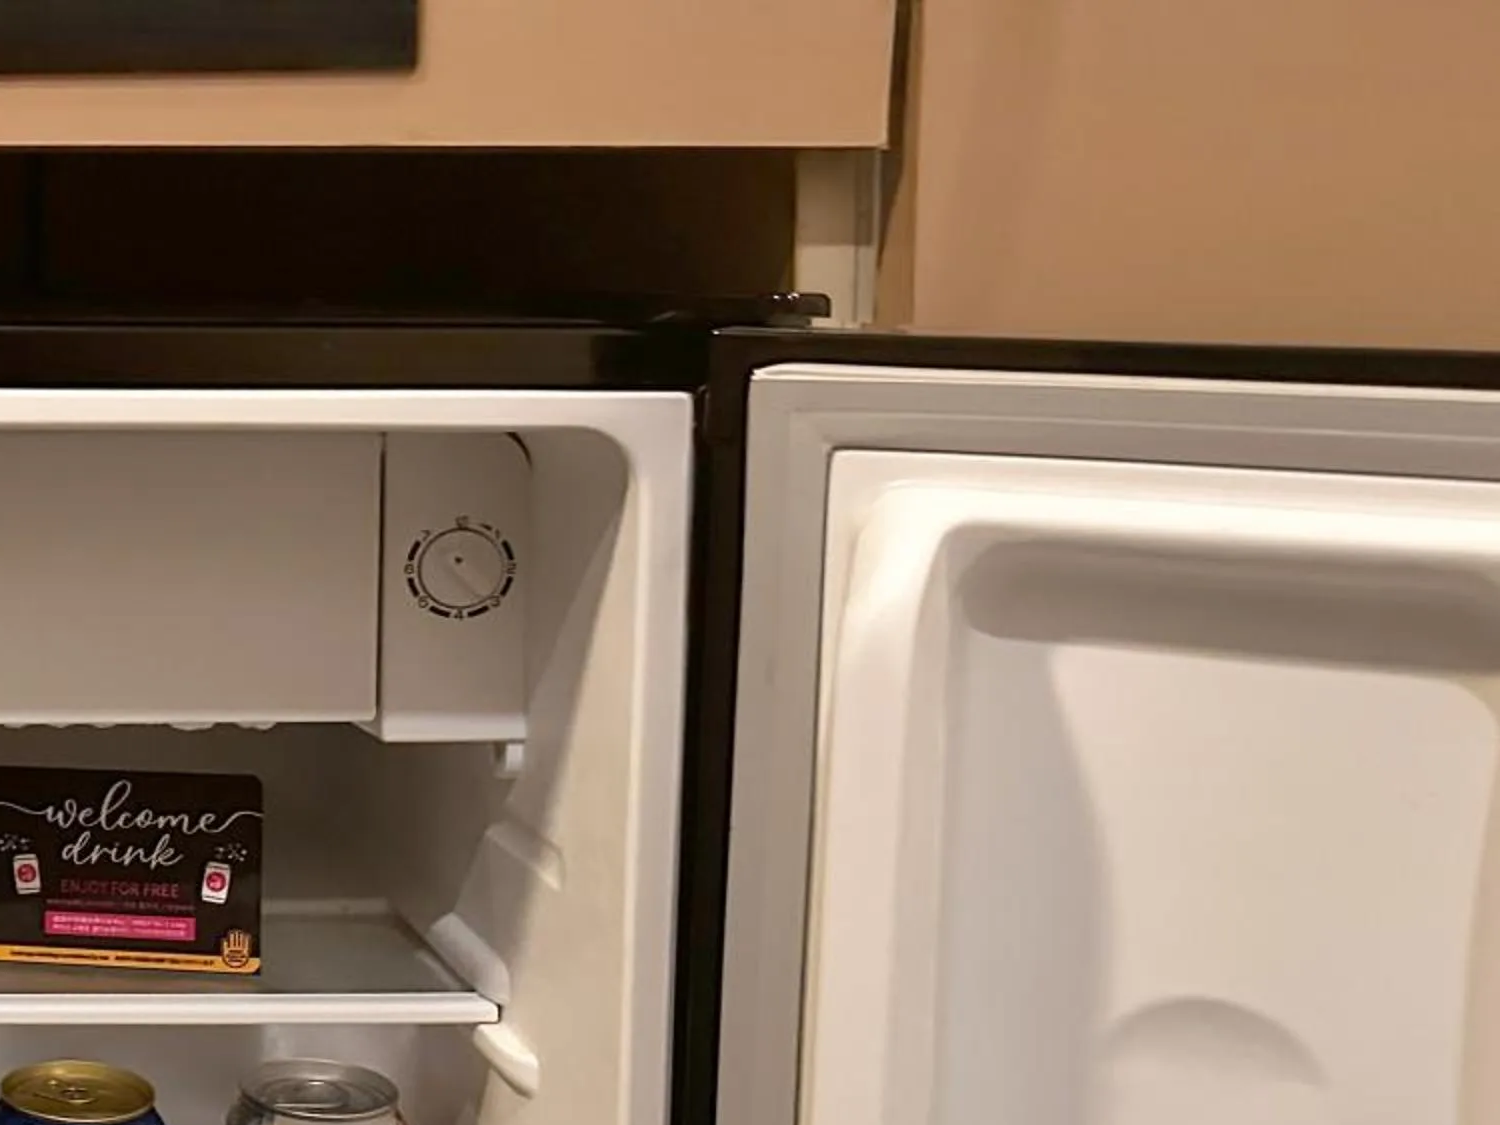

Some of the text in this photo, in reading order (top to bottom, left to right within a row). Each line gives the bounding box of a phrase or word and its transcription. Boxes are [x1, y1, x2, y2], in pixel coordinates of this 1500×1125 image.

[42, 779, 226, 834] welcome
[60, 831, 184, 870] drink
[110, 880, 140, 897] FOR
[143, 882, 180, 898] FREE
